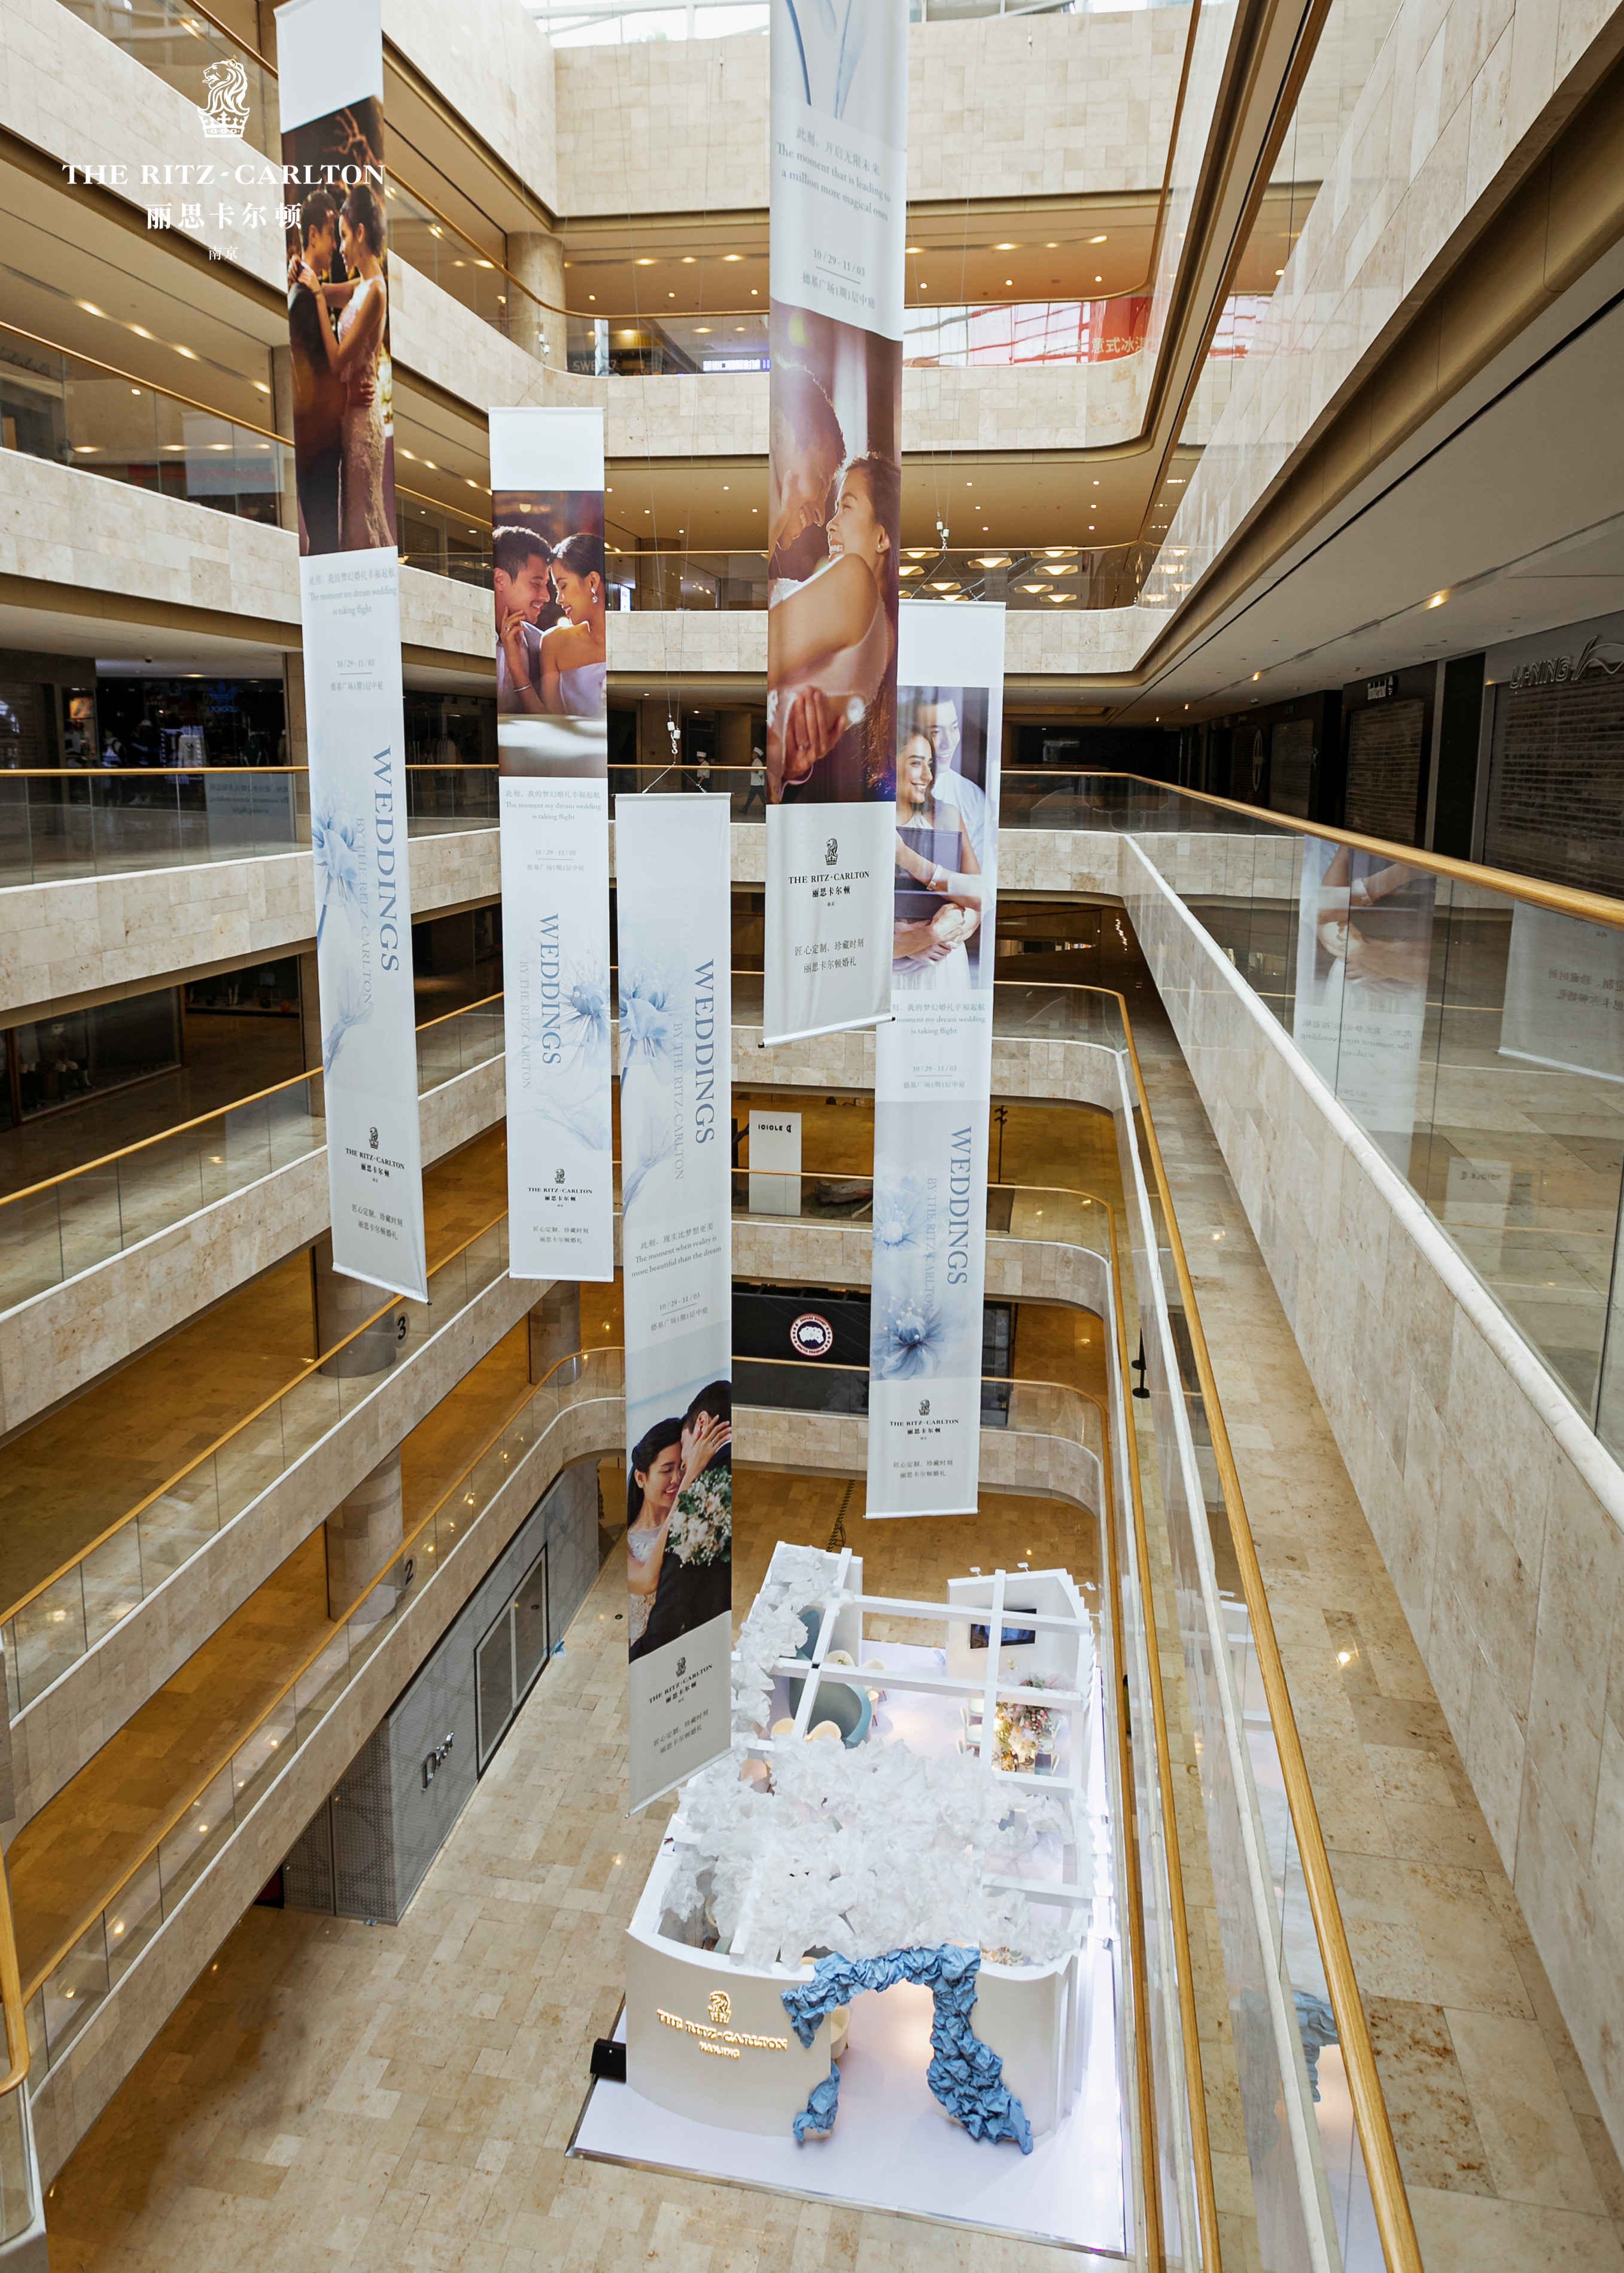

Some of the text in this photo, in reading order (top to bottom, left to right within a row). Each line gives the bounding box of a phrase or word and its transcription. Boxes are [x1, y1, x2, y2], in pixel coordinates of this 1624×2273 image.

[777, 141, 891, 202] The moment that is leading to
[781, 169, 889, 221] a million more magical ones
[309, 586, 397, 601] The moment my dream wedding
[339, 605, 355, 616] taking
[357, 604, 372, 616] flight
[1510, 656, 1571, 689] LI-NING
[357, 818, 364, 838] BY
[358, 842, 366, 877] THE
[373, 745, 399, 972] WEDDINGS
[812, 886, 850, 897] 丽思卡尔顿
[519, 961, 528, 975] BY
[804, 957, 856, 973] 丽思卡尔顿婚礼
[520, 978, 529, 1002] THE
[539, 913, 561, 1065] WEDDINGS
[959, 1014, 986, 1023] wedding
[674, 1023, 683, 1039] BY
[940, 1027, 957, 1035] flight
[674, 1042, 683, 1073] THE
[694, 959, 715, 1144] WEDDINGS
[345, 1148, 358, 1157] THE
[928, 1178, 937, 1192] BY
[927, 1195, 936, 1221] THE
[947, 1125, 972, 1285] WEDDINGS
[631, 1268, 648, 1277] more
[649, 1258, 677, 1273] beautiful
[678, 1255, 692, 1264] than
[704, 1246, 722, 1256] dream
[634, 1255, 647, 1264] The
[649, 1249, 674, 1261] moment
[676, 1243, 692, 1253] when
[693, 1238, 711, 1247] reality
[397, 1316, 406, 1340] 3
[405, 1559, 413, 1584] 2
[649, 1693, 663, 1704] THE
[421, 1731, 454, 1793] Dior
[657, 2008, 683, 2029] THE
